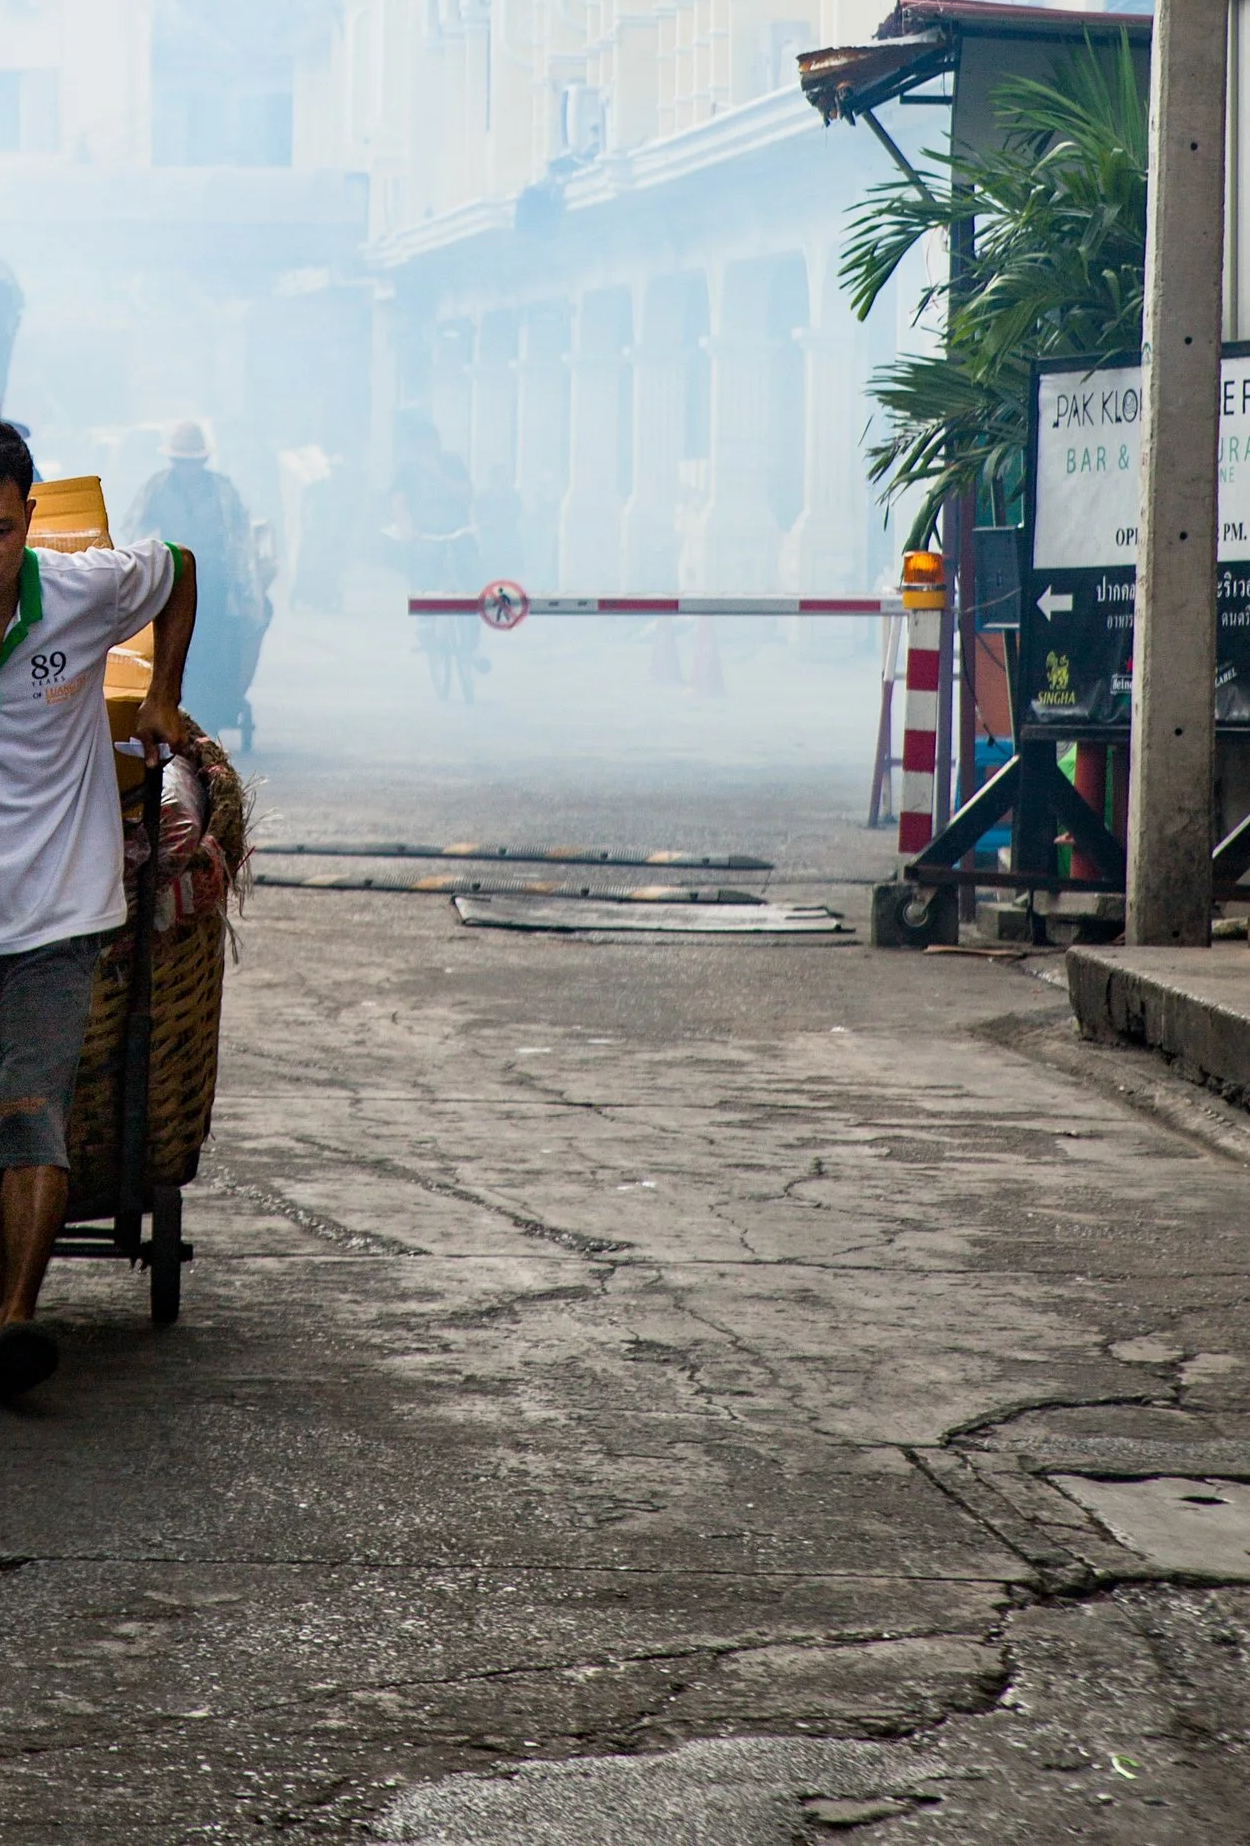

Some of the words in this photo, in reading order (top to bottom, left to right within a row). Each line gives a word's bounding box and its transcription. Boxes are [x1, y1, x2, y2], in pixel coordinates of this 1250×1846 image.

[1052, 391, 1095, 428] PAK
[1101, 388, 1143, 425] KLO
[1066, 446, 1107, 474] BAR
[1118, 444, 1130, 471] &
[1115, 527, 1138, 547] OP
[1223, 522, 1248, 542] PM.
[31, 651, 67, 680] 89
[31, 675, 66, 687] YEARS
[1037, 691, 1077, 705] SINGHA
